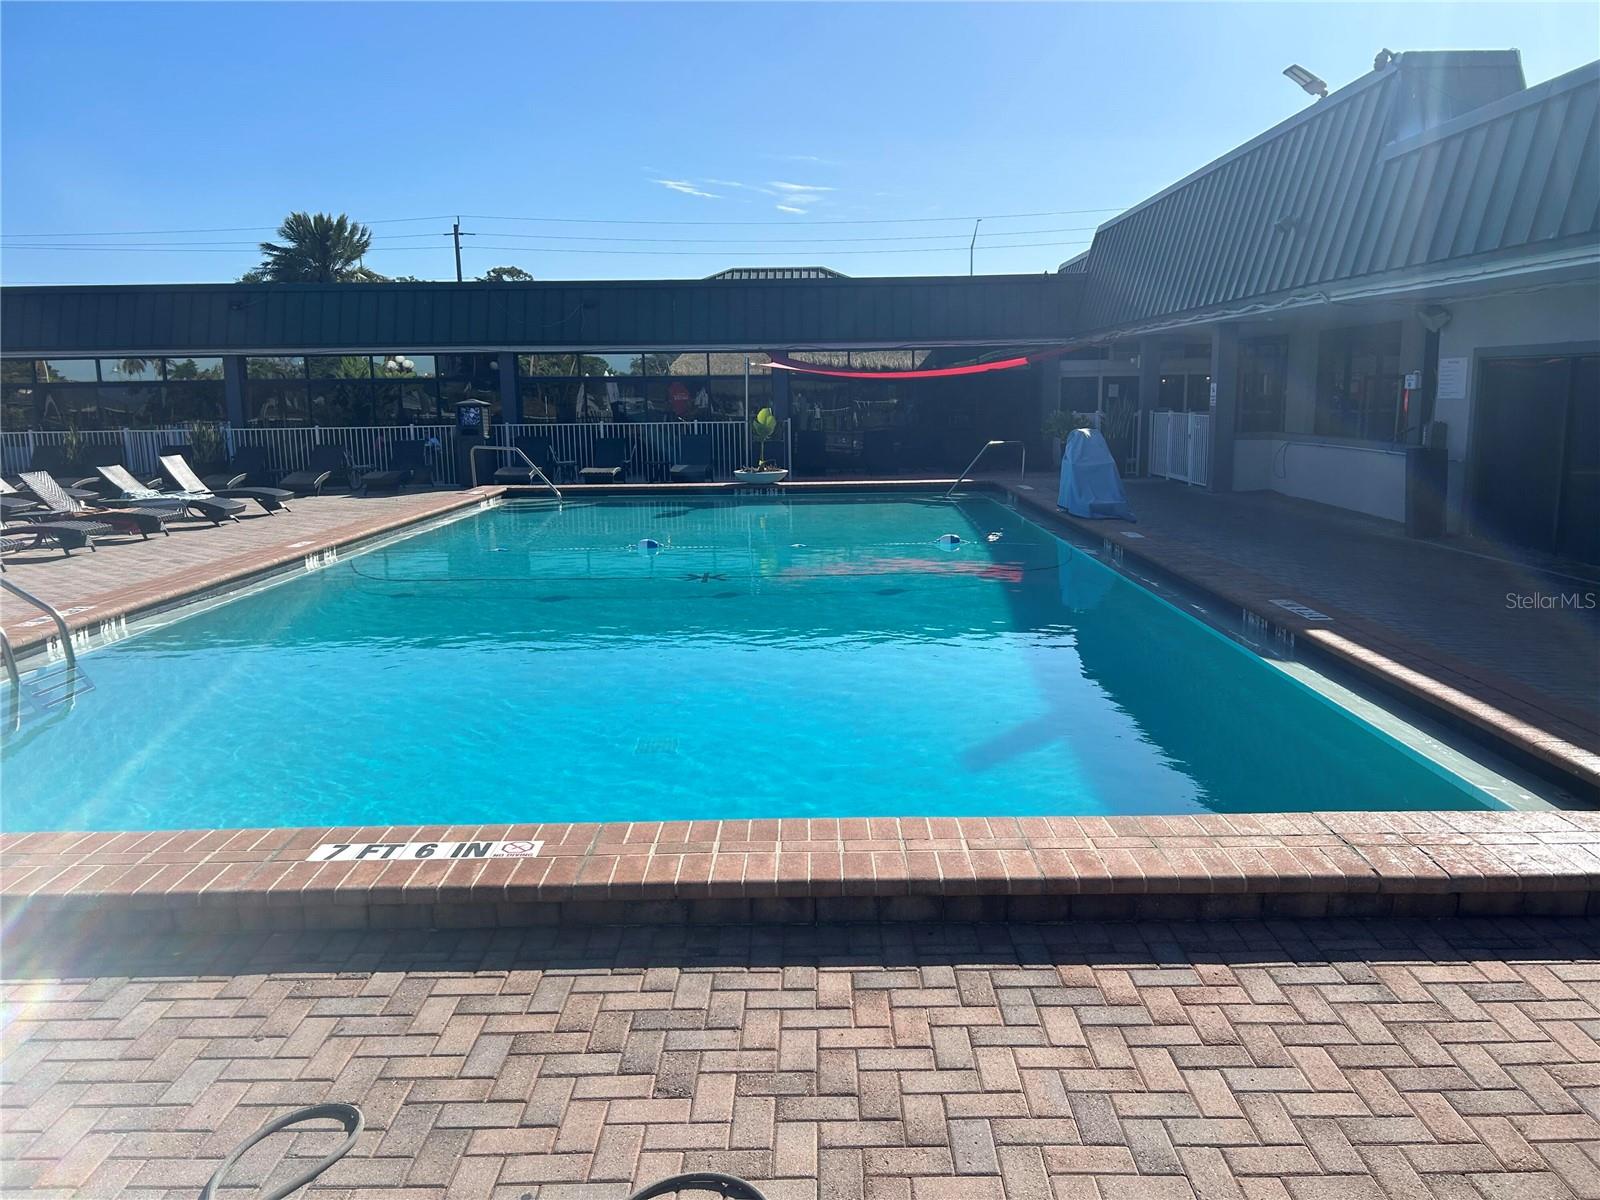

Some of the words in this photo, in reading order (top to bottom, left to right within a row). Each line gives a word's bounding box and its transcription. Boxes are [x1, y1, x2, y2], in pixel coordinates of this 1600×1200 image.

[323, 844, 352, 861] 7
[355, 843, 405, 860] FT
[414, 843, 436, 859] 6
[450, 842, 493, 858] IN
